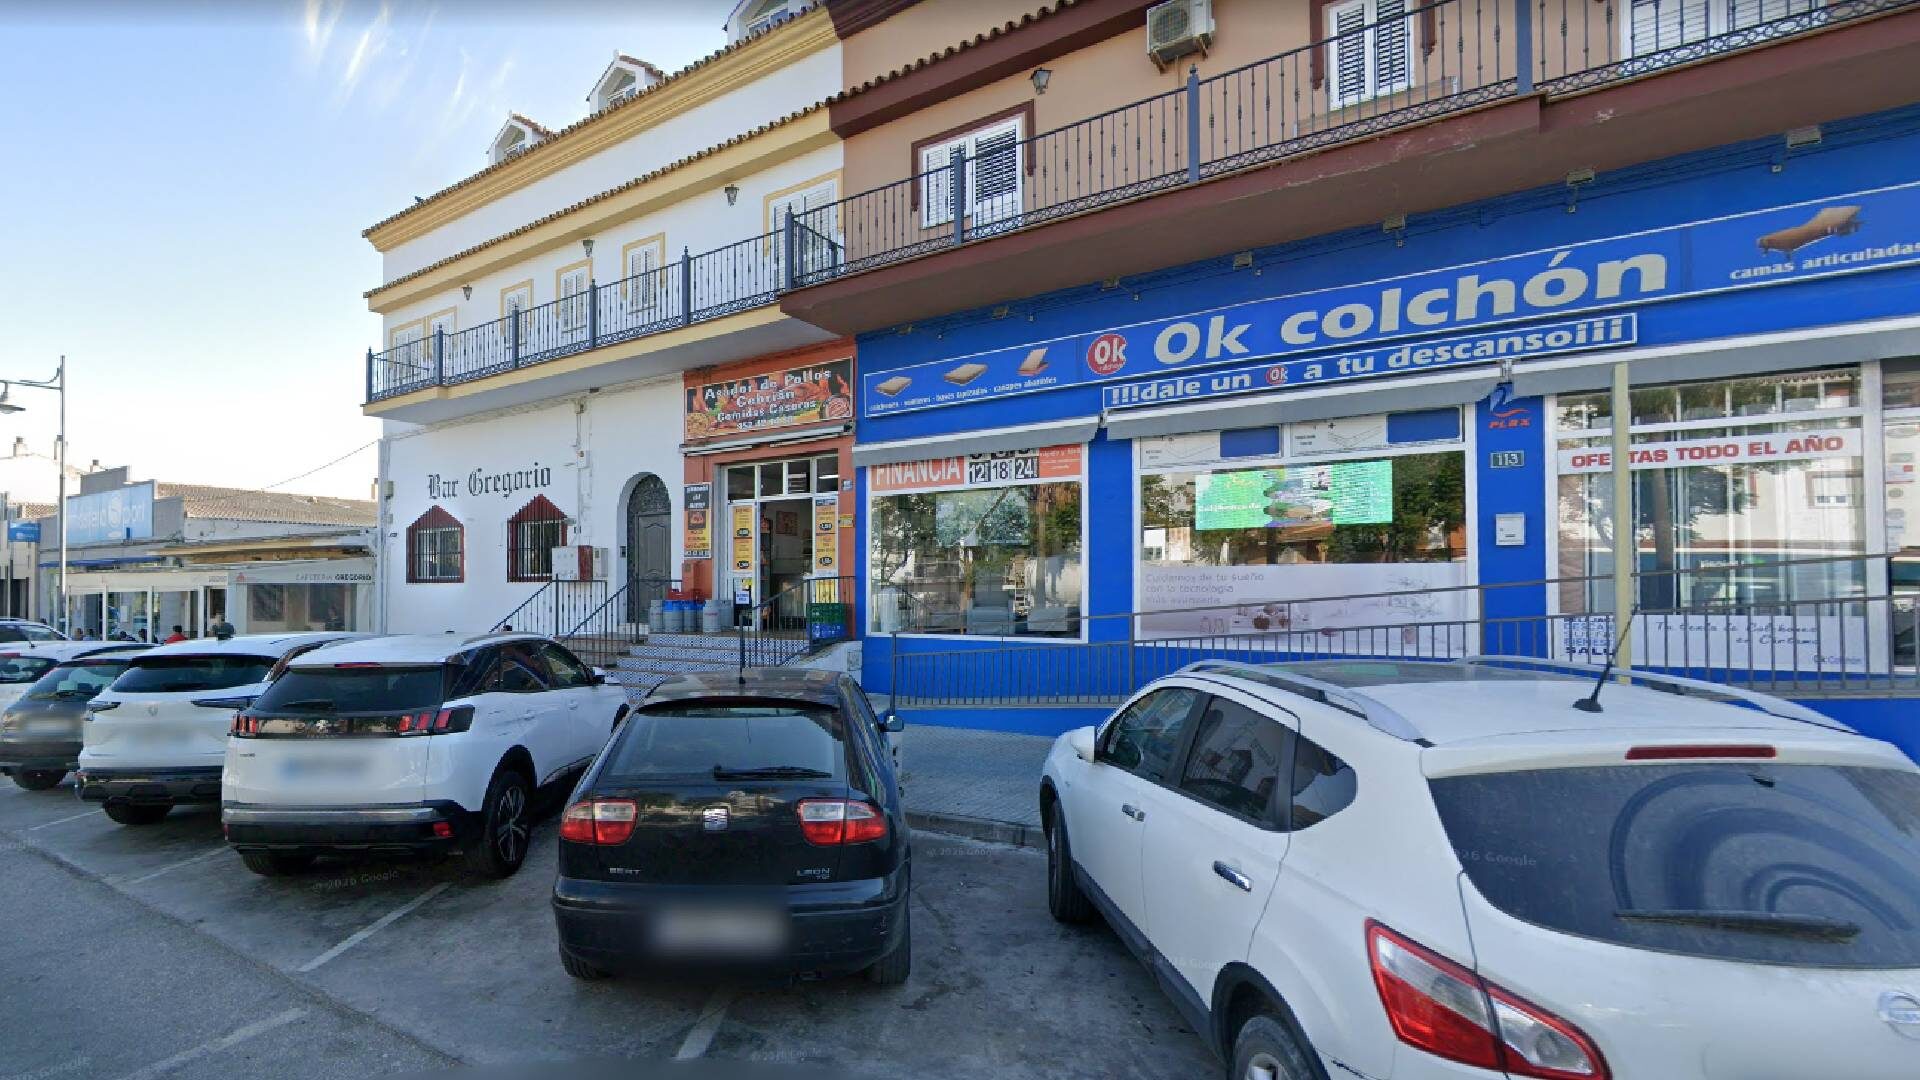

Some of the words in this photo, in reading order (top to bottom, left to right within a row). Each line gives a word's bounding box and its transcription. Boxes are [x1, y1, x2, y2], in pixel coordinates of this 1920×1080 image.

[1729, 261, 1795, 280] camas
[1154, 314, 1251, 365] Ok
[1280, 251, 1668, 347] colchón
[1094, 337, 1127, 365] Ok
[704, 382, 753, 401] Asador
[760, 379, 778, 391] de
[784, 368, 832, 386] Pollos
[1211, 373, 1252, 391] un
[1303, 362, 1323, 380] a
[1336, 354, 1375, 376] tu
[769, 399, 817, 414] Caseras
[1496, 453, 1519, 466] 113
[1571, 449, 1669, 468] OFETAS
[1675, 443, 1740, 462] TODO
[1747, 440, 1778, 457] EL
[1784, 434, 1844, 454] AÑO
[427, 473, 459, 500] Bar
[468, 462, 551, 499] Gregorio
[876, 456, 961, 486] FINANCIA
[993, 461, 1009, 480] 18
[1015, 459, 1033, 478] 24
[335, 573, 372, 581] GREGORIO
[1145, 573, 1196, 583] Cuidamos
[1199, 572, 1213, 581] de
[1216, 573, 1228, 582] tu
[1231, 572, 1265, 582] sueño
